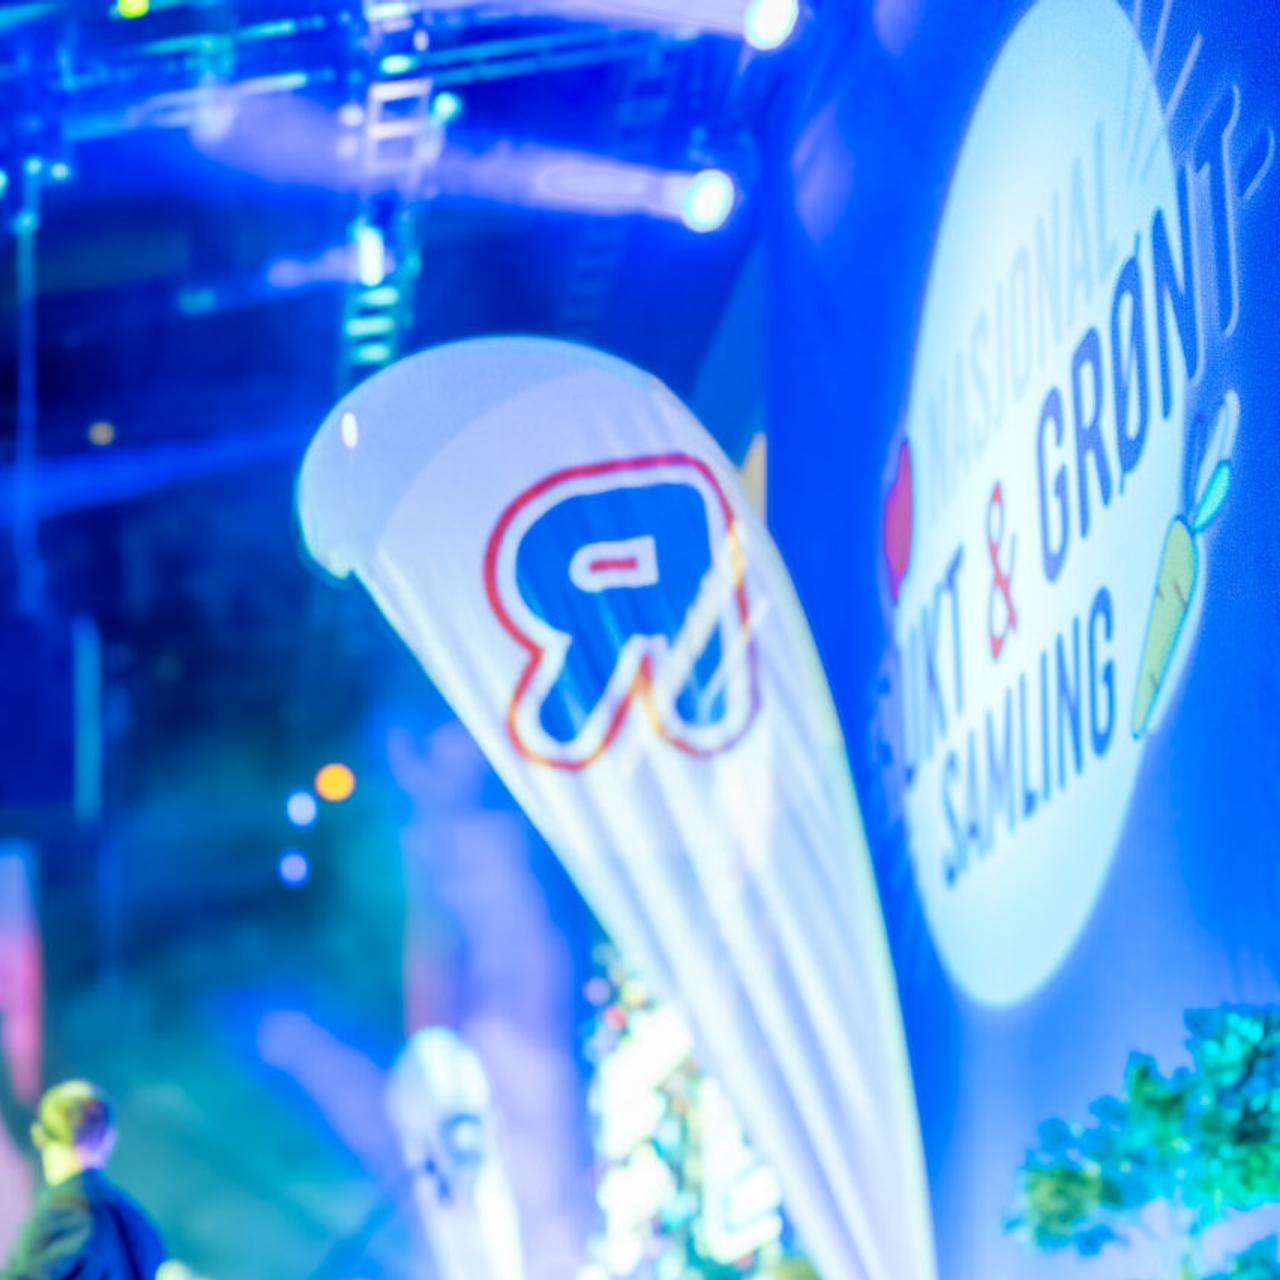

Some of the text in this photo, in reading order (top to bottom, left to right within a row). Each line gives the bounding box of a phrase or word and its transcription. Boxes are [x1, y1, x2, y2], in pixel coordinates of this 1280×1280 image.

[986, 479, 1018, 662] &
[1037, 85, 1240, 582] GRØNT
[942, 586, 1117, 891] SAMLING
